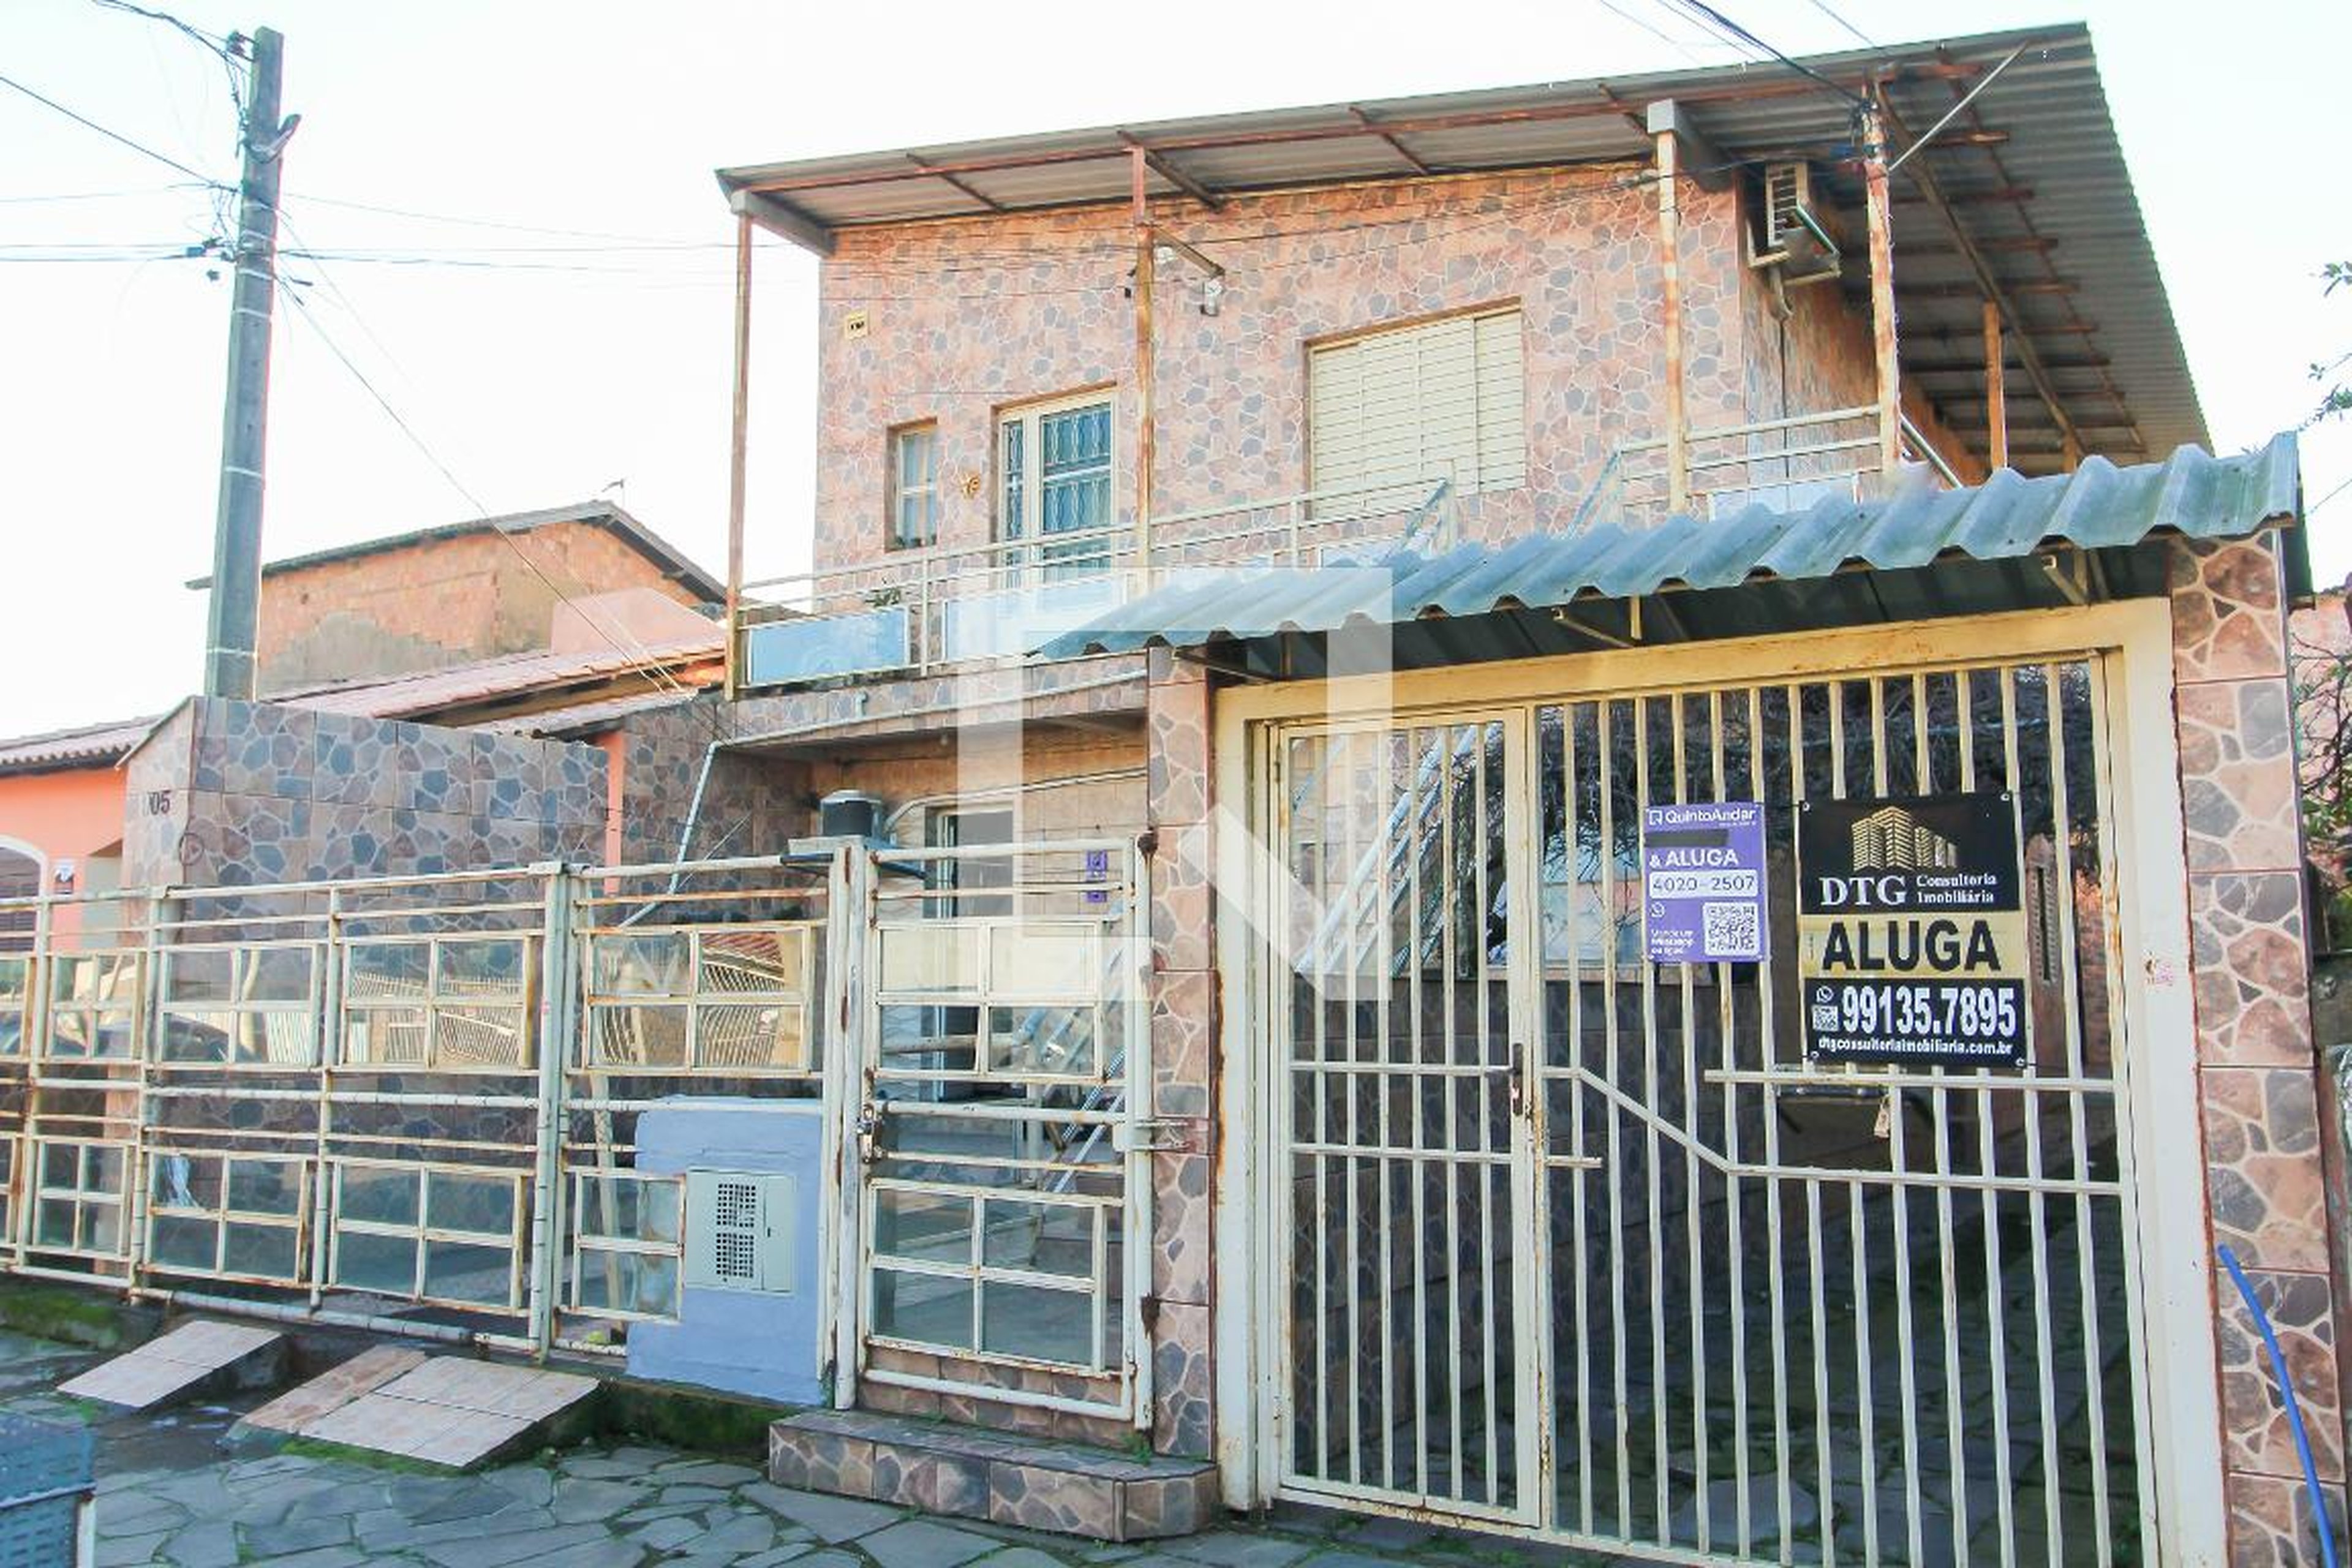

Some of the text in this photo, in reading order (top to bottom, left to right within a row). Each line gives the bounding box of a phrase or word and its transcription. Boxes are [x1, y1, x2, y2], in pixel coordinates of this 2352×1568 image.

[1665, 809, 1756, 823] QuintoAndar
[1665, 849, 1739, 866] ALUGA
[1917, 873, 1997, 887] Consultoria
[1819, 876, 1906, 906] DTG
[1917, 890, 1994, 903] Imobiliária
[1822, 920, 2002, 971] ALUGA
[1842, 986, 2017, 1036] 99135.7895
